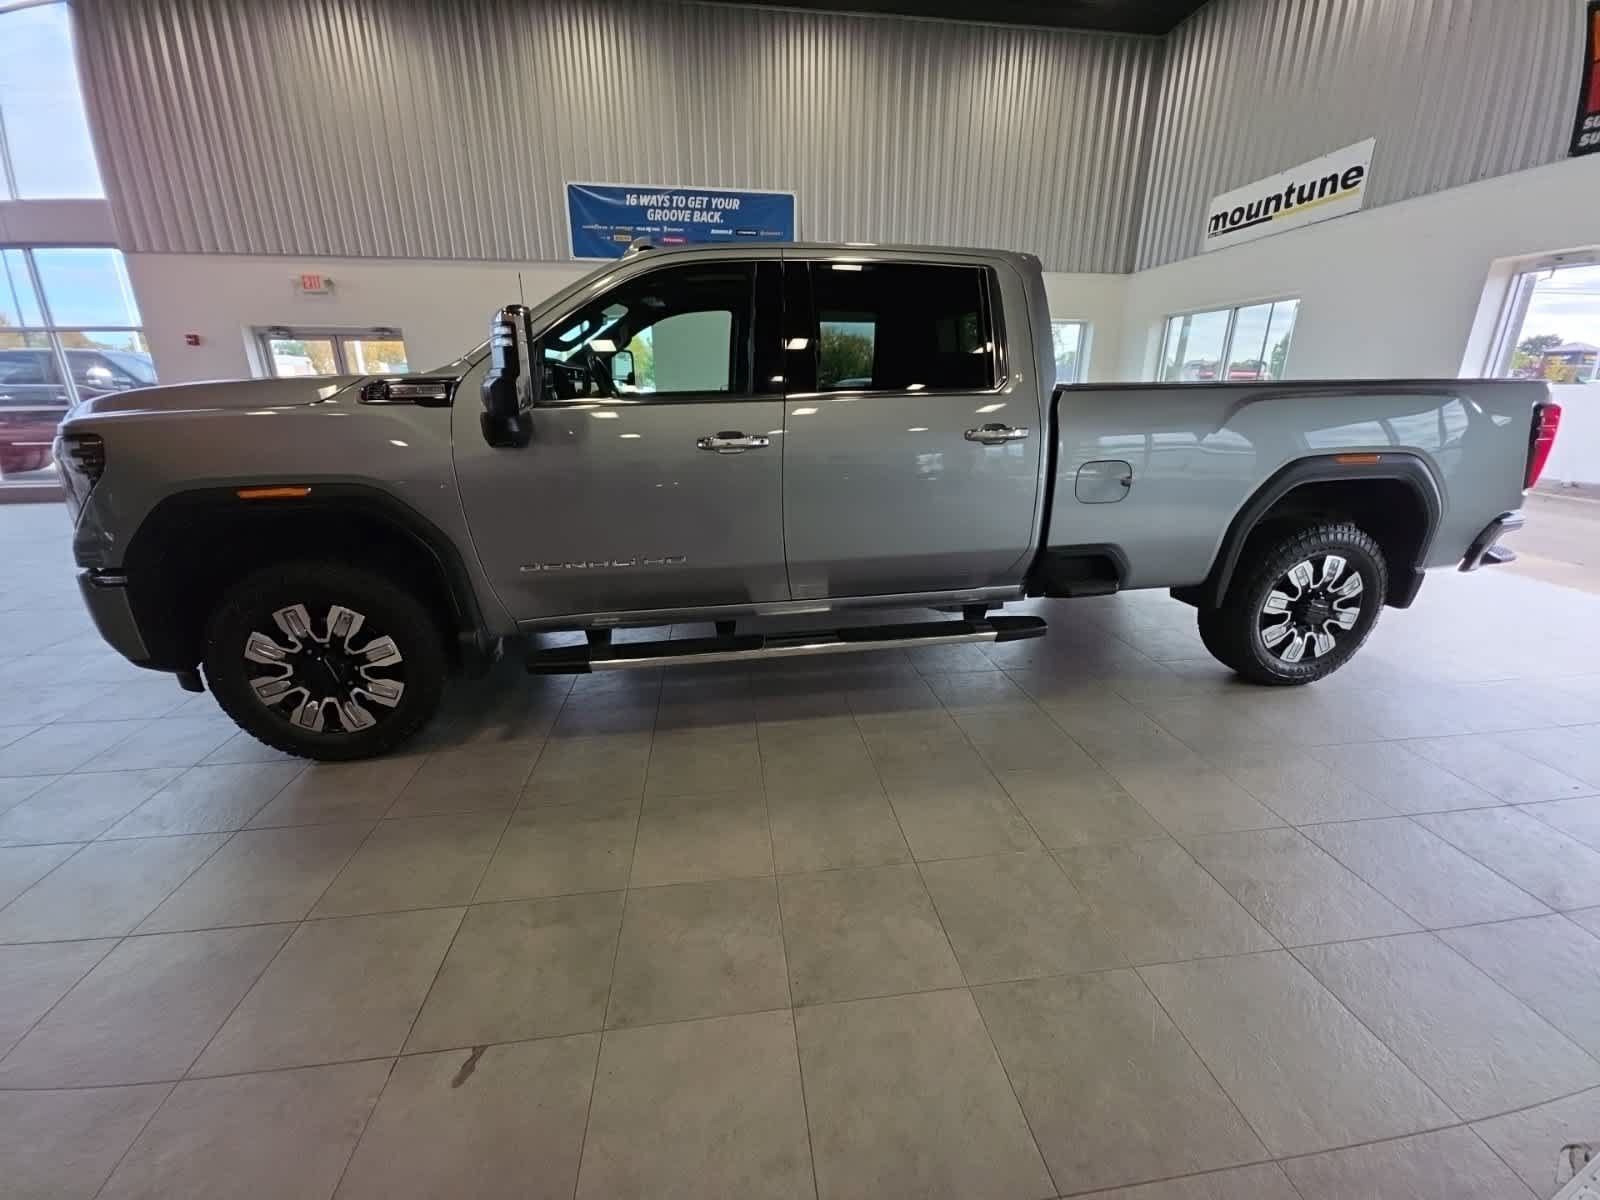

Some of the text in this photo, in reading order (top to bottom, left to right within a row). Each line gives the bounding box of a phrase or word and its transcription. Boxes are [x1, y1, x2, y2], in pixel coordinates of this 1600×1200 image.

[625, 194, 740, 210] 16 WAYS TO GET YOUR
[1208, 165, 1364, 233] mountune
[647, 210, 724, 224] GROOVE BACK.
